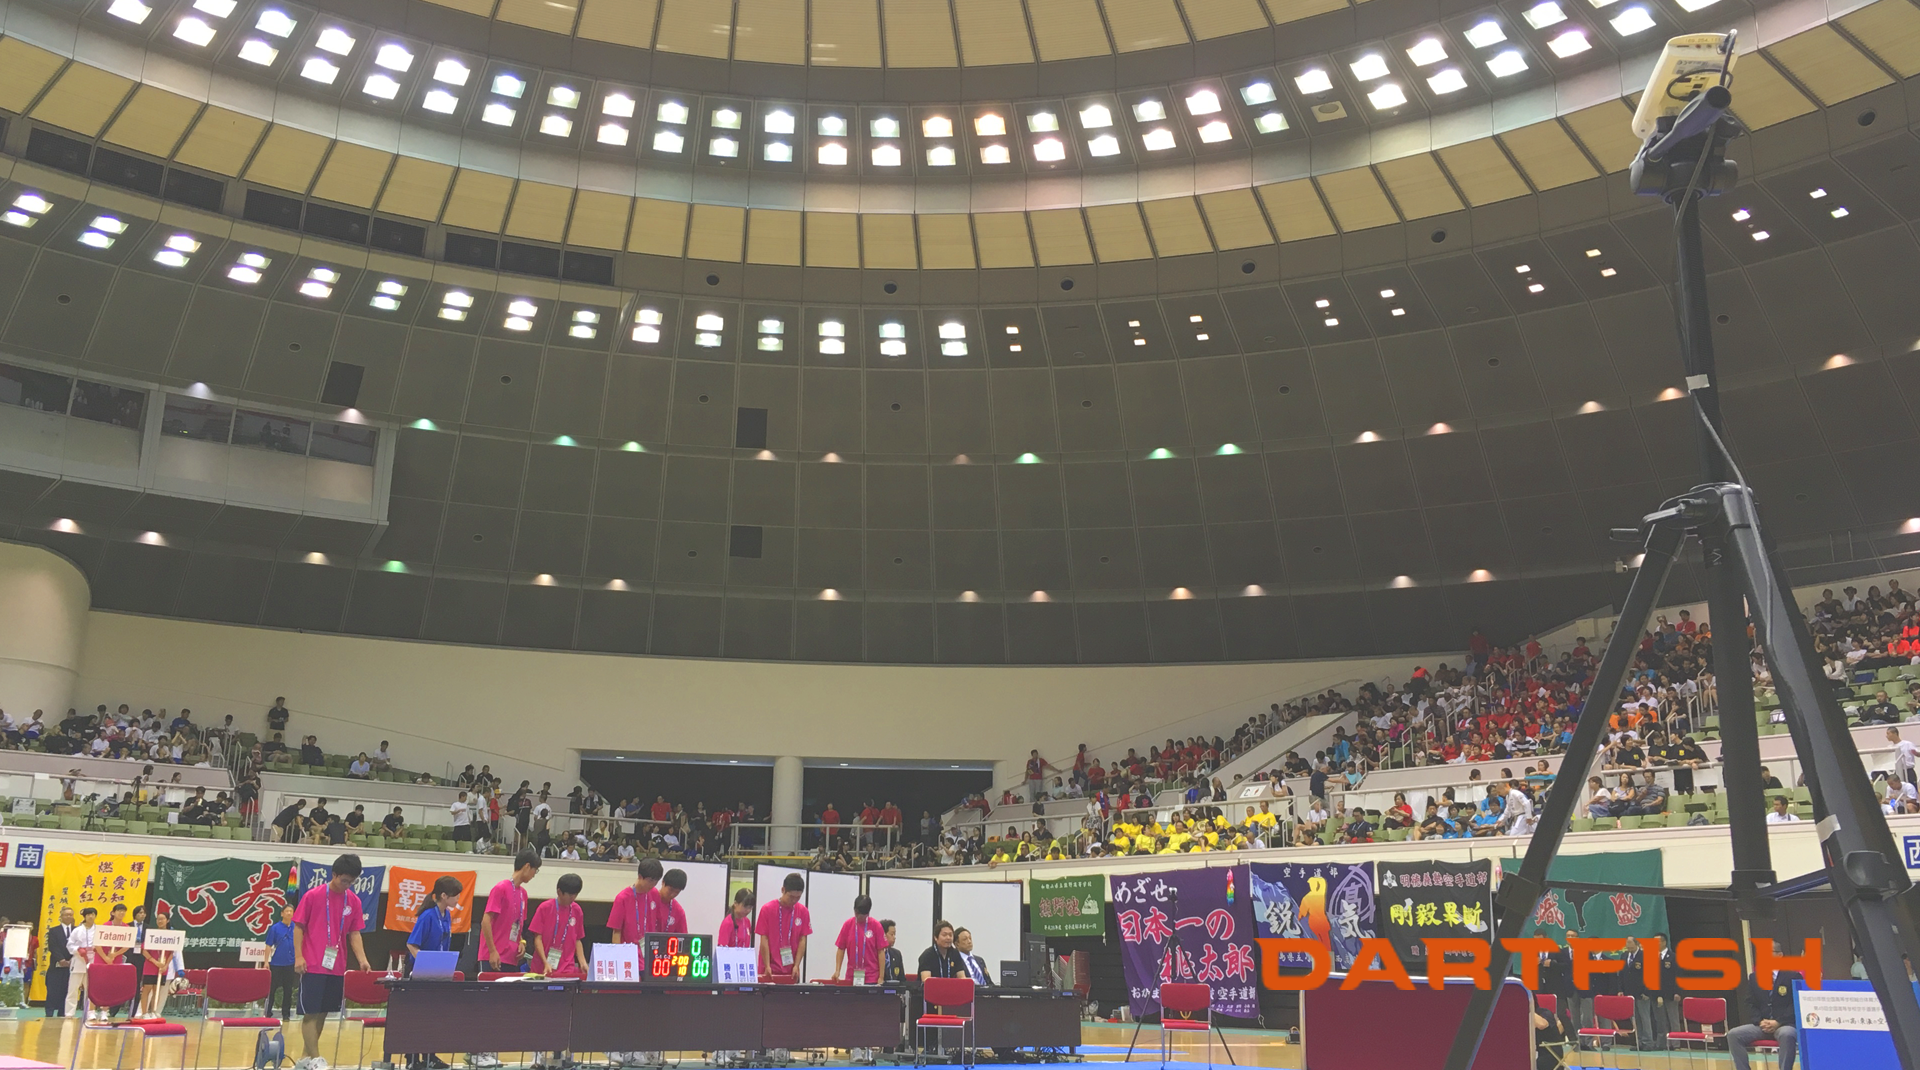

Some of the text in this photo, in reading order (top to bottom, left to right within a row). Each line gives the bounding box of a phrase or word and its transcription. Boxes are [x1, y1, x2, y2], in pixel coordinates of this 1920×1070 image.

[19, 846, 41, 866] 南
[1115, 877, 1168, 904] めざせ
[1117, 905, 1235, 944] 日本一の
[667, 937, 678, 956] 0
[691, 938, 701, 956] 0
